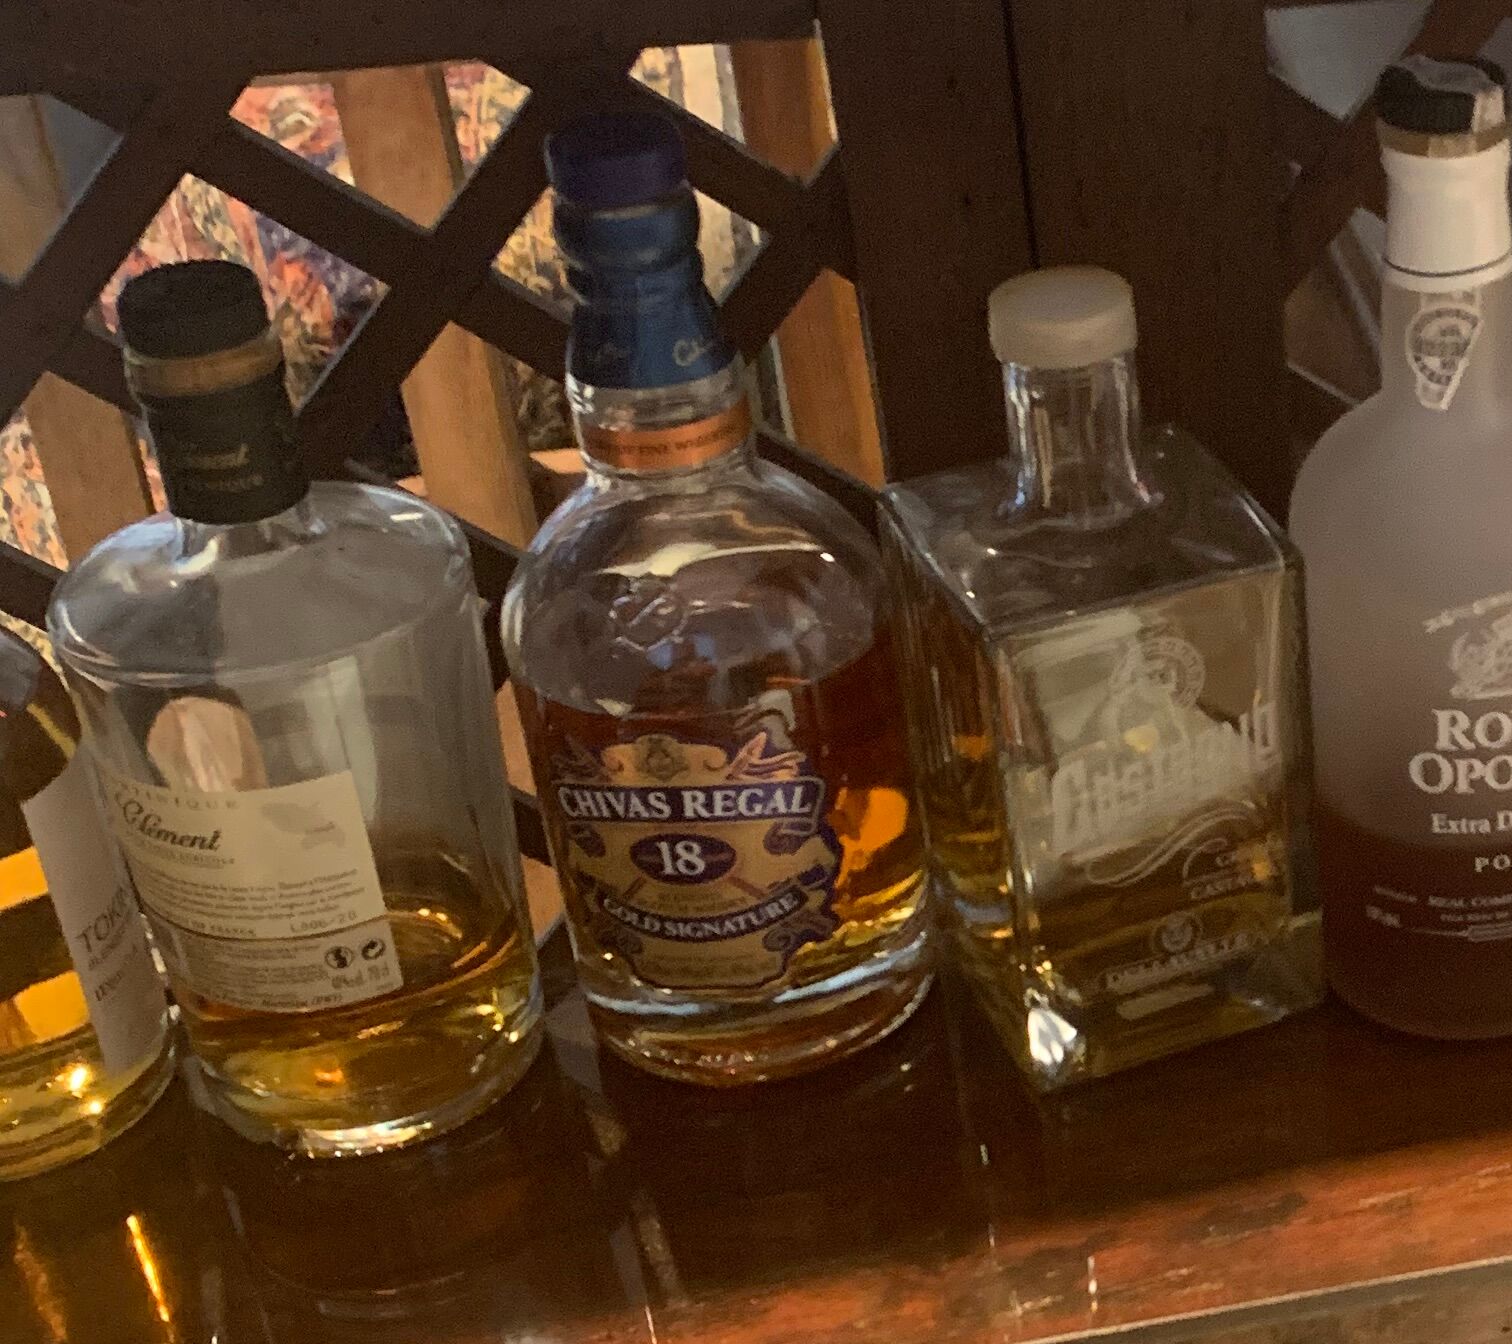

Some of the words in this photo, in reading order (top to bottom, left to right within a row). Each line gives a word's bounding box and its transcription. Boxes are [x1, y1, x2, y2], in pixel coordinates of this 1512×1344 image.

[558, 786, 672, 819] CHIVAS
[682, 785, 811, 818] REGAL
[1430, 812, 1492, 835] Extra
[656, 840, 706, 877] 18
[603, 897, 661, 933] GOLD
[663, 893, 800, 938] SIGNATURE
